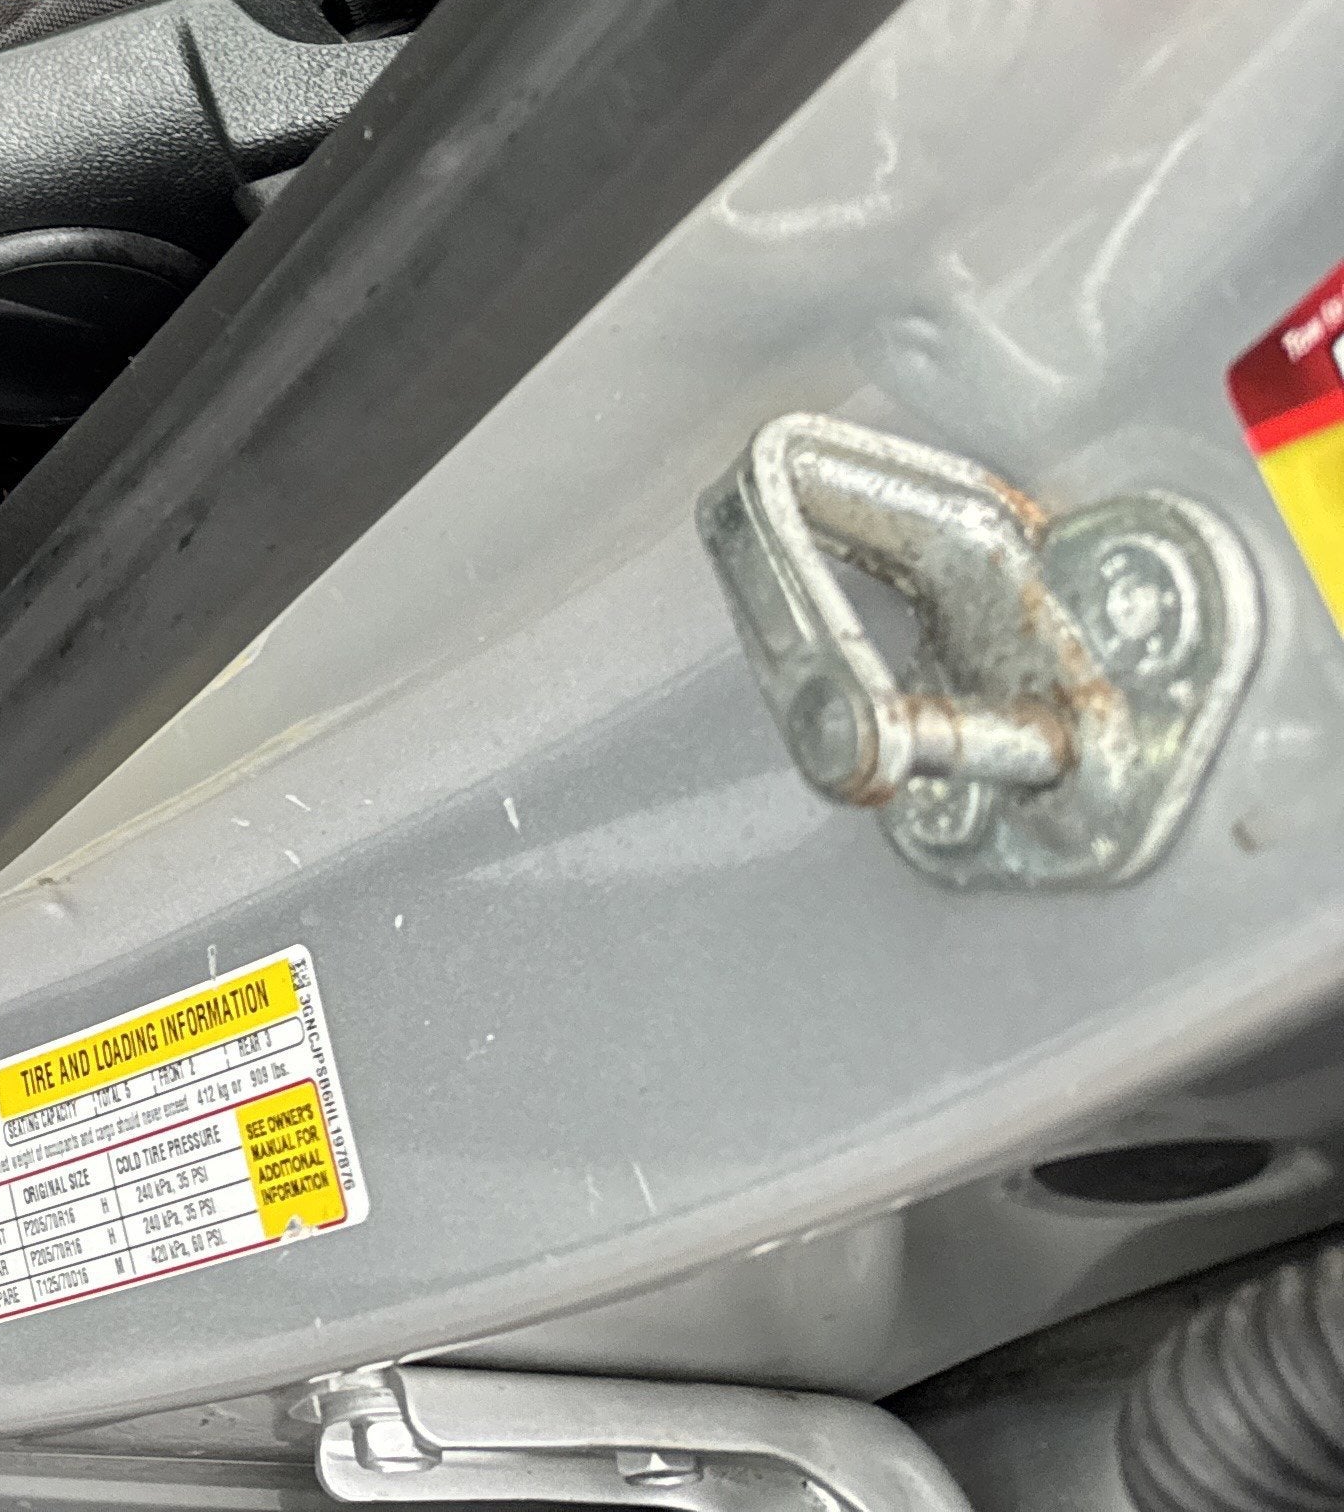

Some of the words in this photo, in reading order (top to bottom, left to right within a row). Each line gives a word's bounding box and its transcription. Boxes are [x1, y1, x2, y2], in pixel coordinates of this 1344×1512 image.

[20, 1061, 55, 1097] TIRE
[59, 1049, 90, 1085] AND
[93, 1022, 158, 1071] LOADING
[160, 979, 269, 1046] INFORMATION
[7, 1113, 40, 1139] SEATING
[40, 1100, 77, 1127] CAPACITY
[96, 1085, 122, 1108] TOTAL
[158, 1060, 185, 1086] FRONT
[237, 1033, 262, 1057] REAR
[197, 1085, 216, 1105] 412
[216, 1082, 230, 1101] kg
[231, 1079, 242, 1094] or
[245, 1119, 267, 1141] SEE
[267, 1103, 314, 1134] OWNER'S
[250, 1131, 296, 1162] MANUAL
[296, 1125, 320, 1148] FOR
[23, 1176, 67, 1205] ORIGINAL
[69, 1168, 91, 1190] SIZE
[115, 1151, 141, 1175] COLD
[142, 1143, 167, 1167] TIRE
[167, 1124, 222, 1159] PRESSURE
[258, 1148, 324, 1184] ADDITIONAL
[100, 1197, 110, 1214] H
[135, 1183, 154, 1203] 240
[176, 1170, 190, 1190] 35
[191, 1165, 209, 1186] PSI
[262, 1170, 330, 1206] INFORMATION
[107, 1227, 117, 1245] H
[184, 1202, 197, 1221] 35
[198, 1197, 216, 1217] PSI
